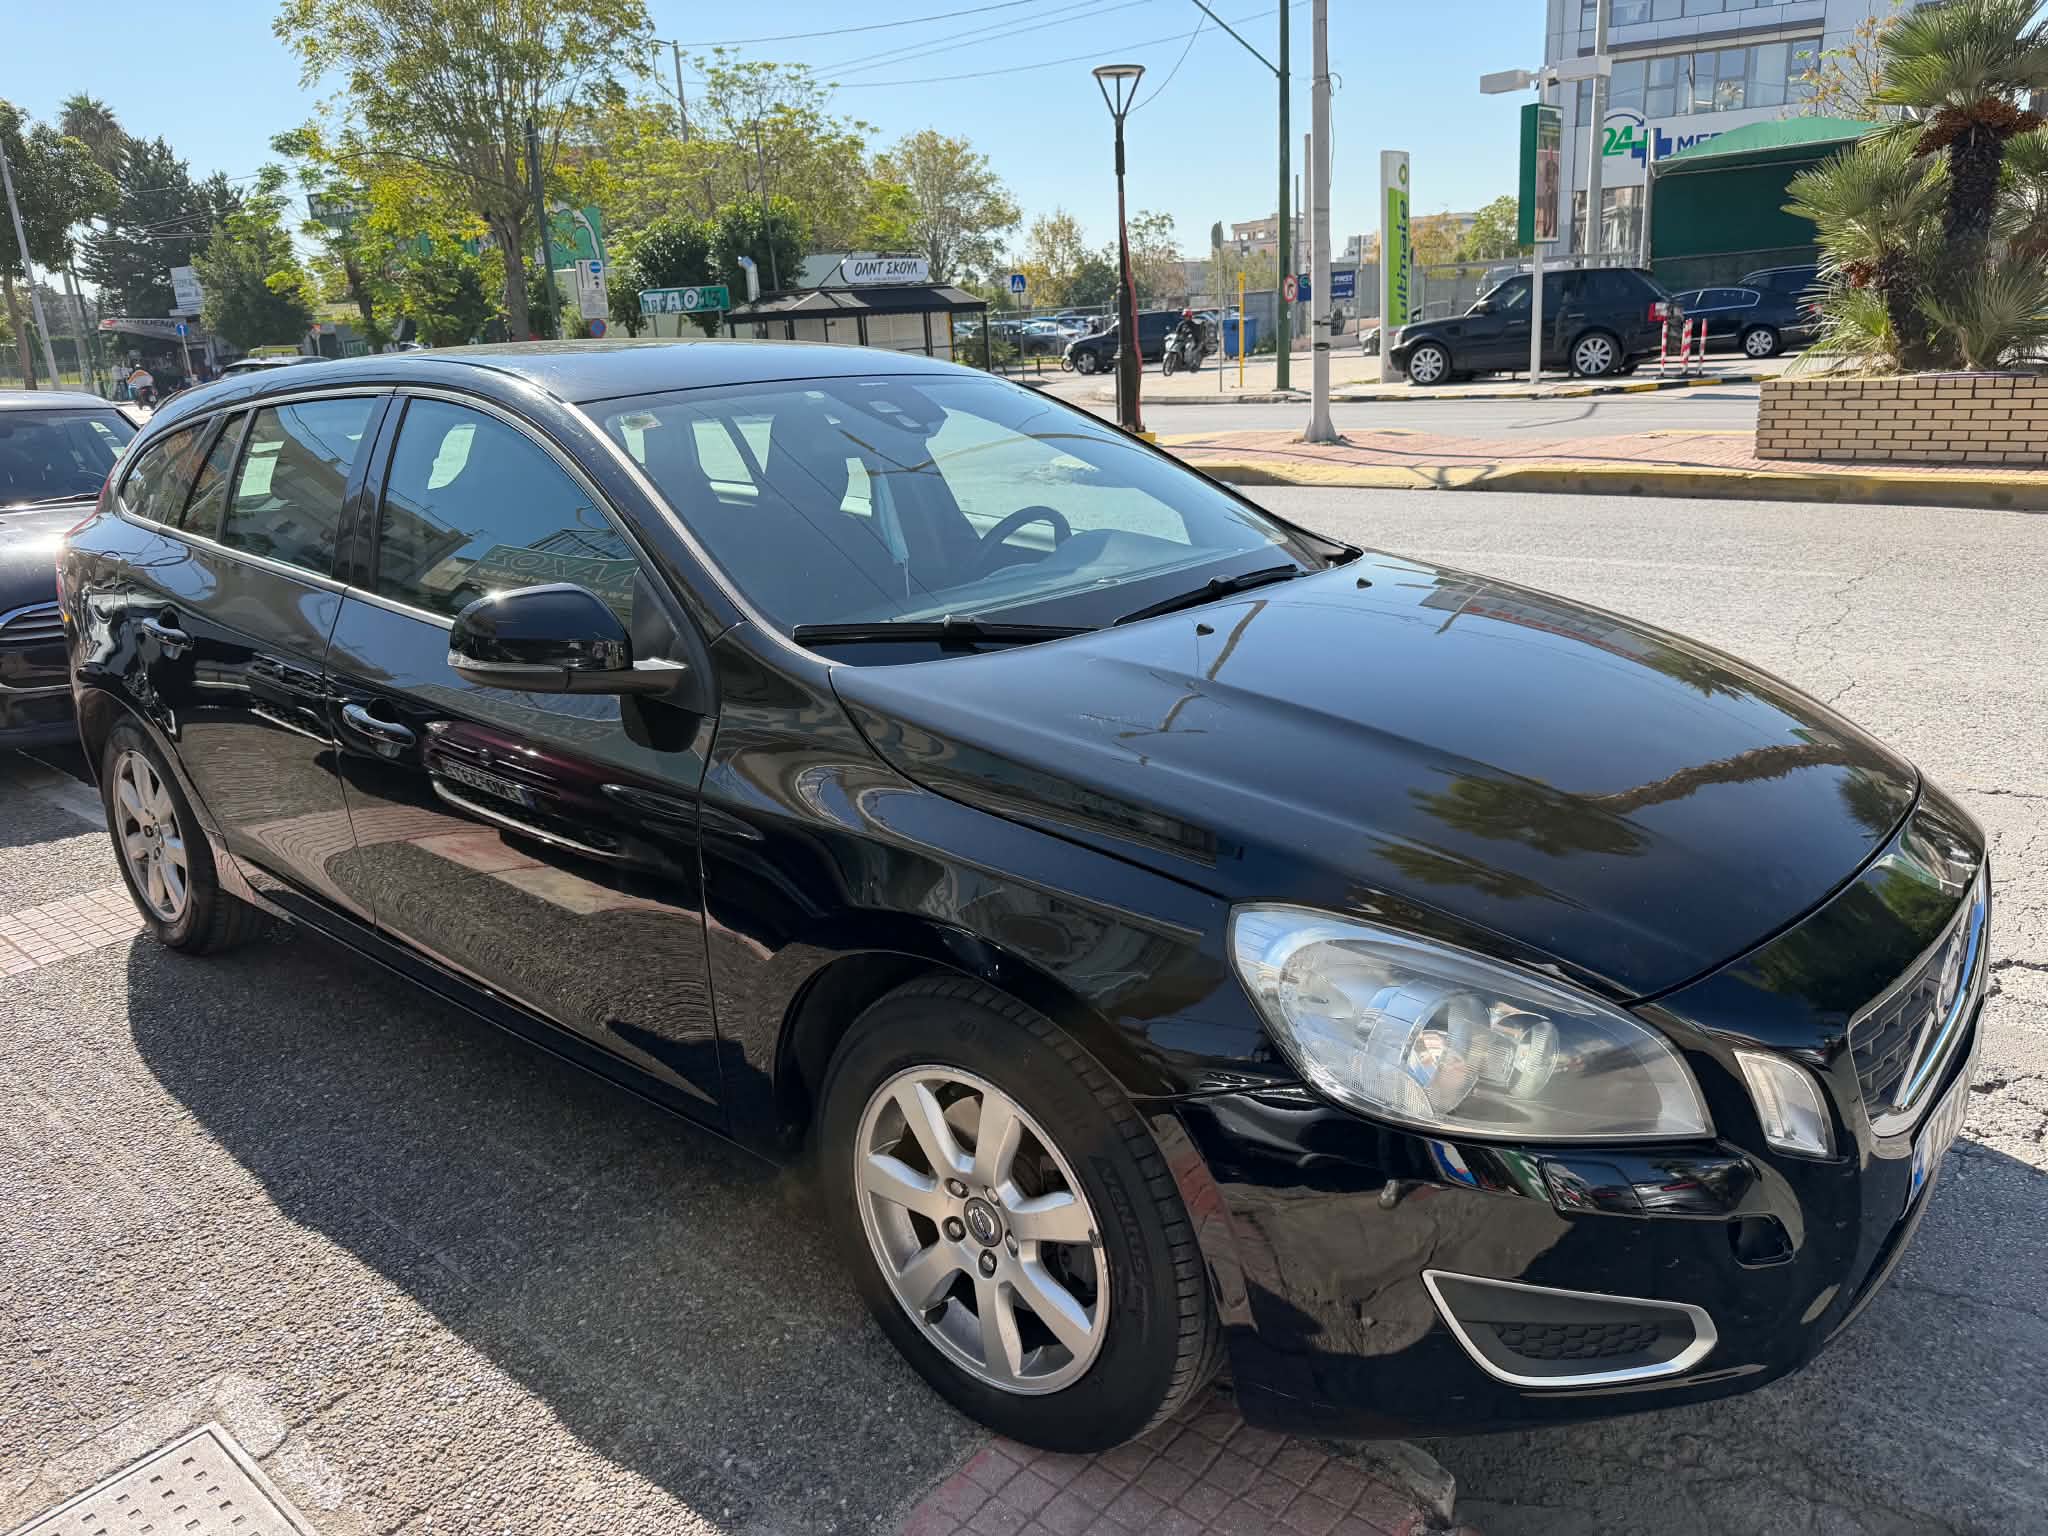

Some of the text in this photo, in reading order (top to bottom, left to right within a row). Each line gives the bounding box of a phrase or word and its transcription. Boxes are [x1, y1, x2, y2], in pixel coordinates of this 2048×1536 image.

[1602, 125, 1642, 156] 24
[886, 261, 918, 275] ΣΚΟΥΛ
[1396, 199, 1408, 321] ultimate
